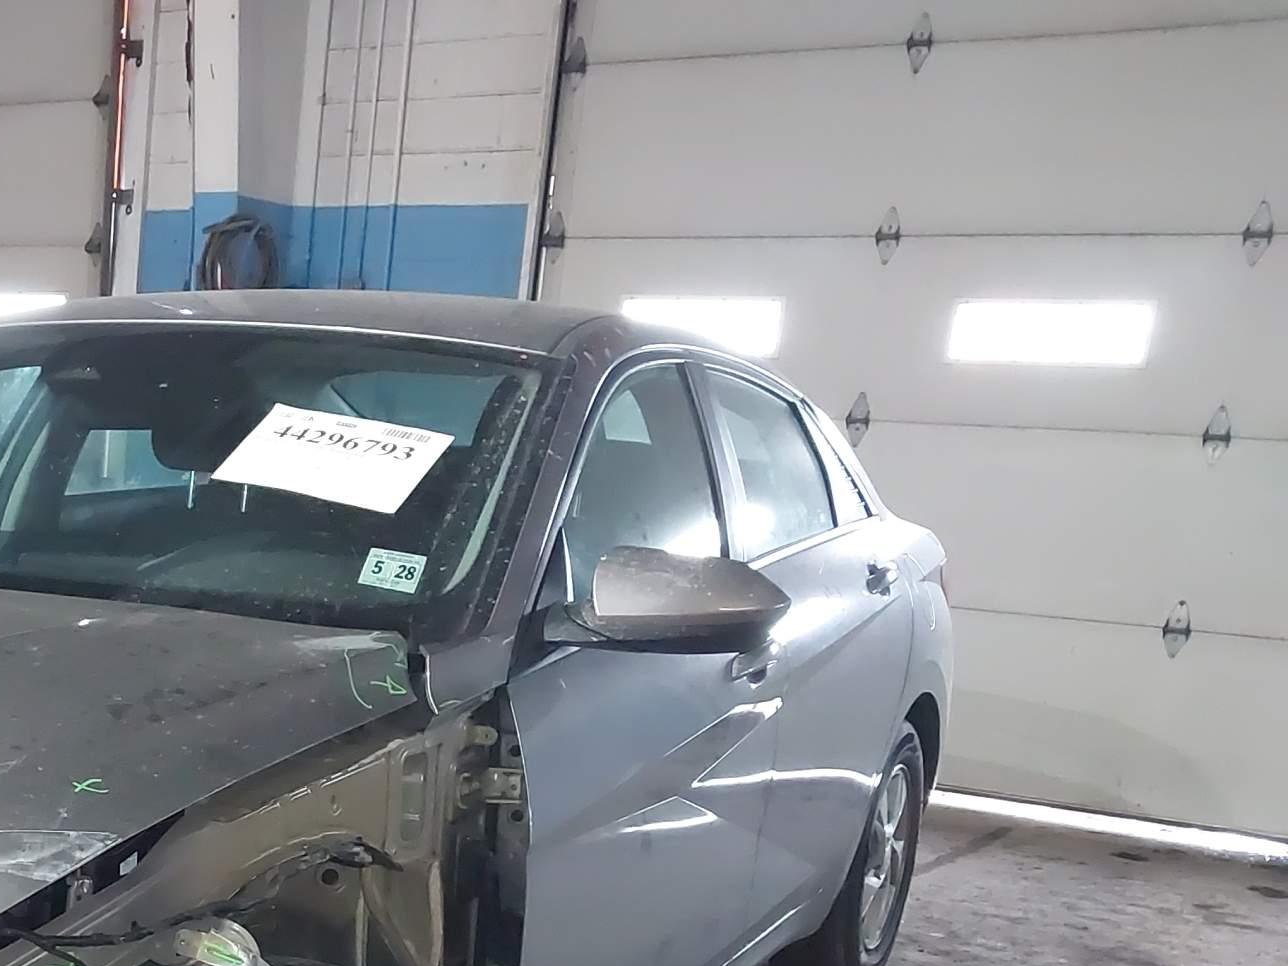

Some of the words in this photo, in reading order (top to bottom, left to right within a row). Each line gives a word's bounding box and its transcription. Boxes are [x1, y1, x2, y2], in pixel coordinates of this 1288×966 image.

[273, 425, 416, 461] 44296793
[371, 560, 385, 575] 5
[394, 564, 417, 581] 28
